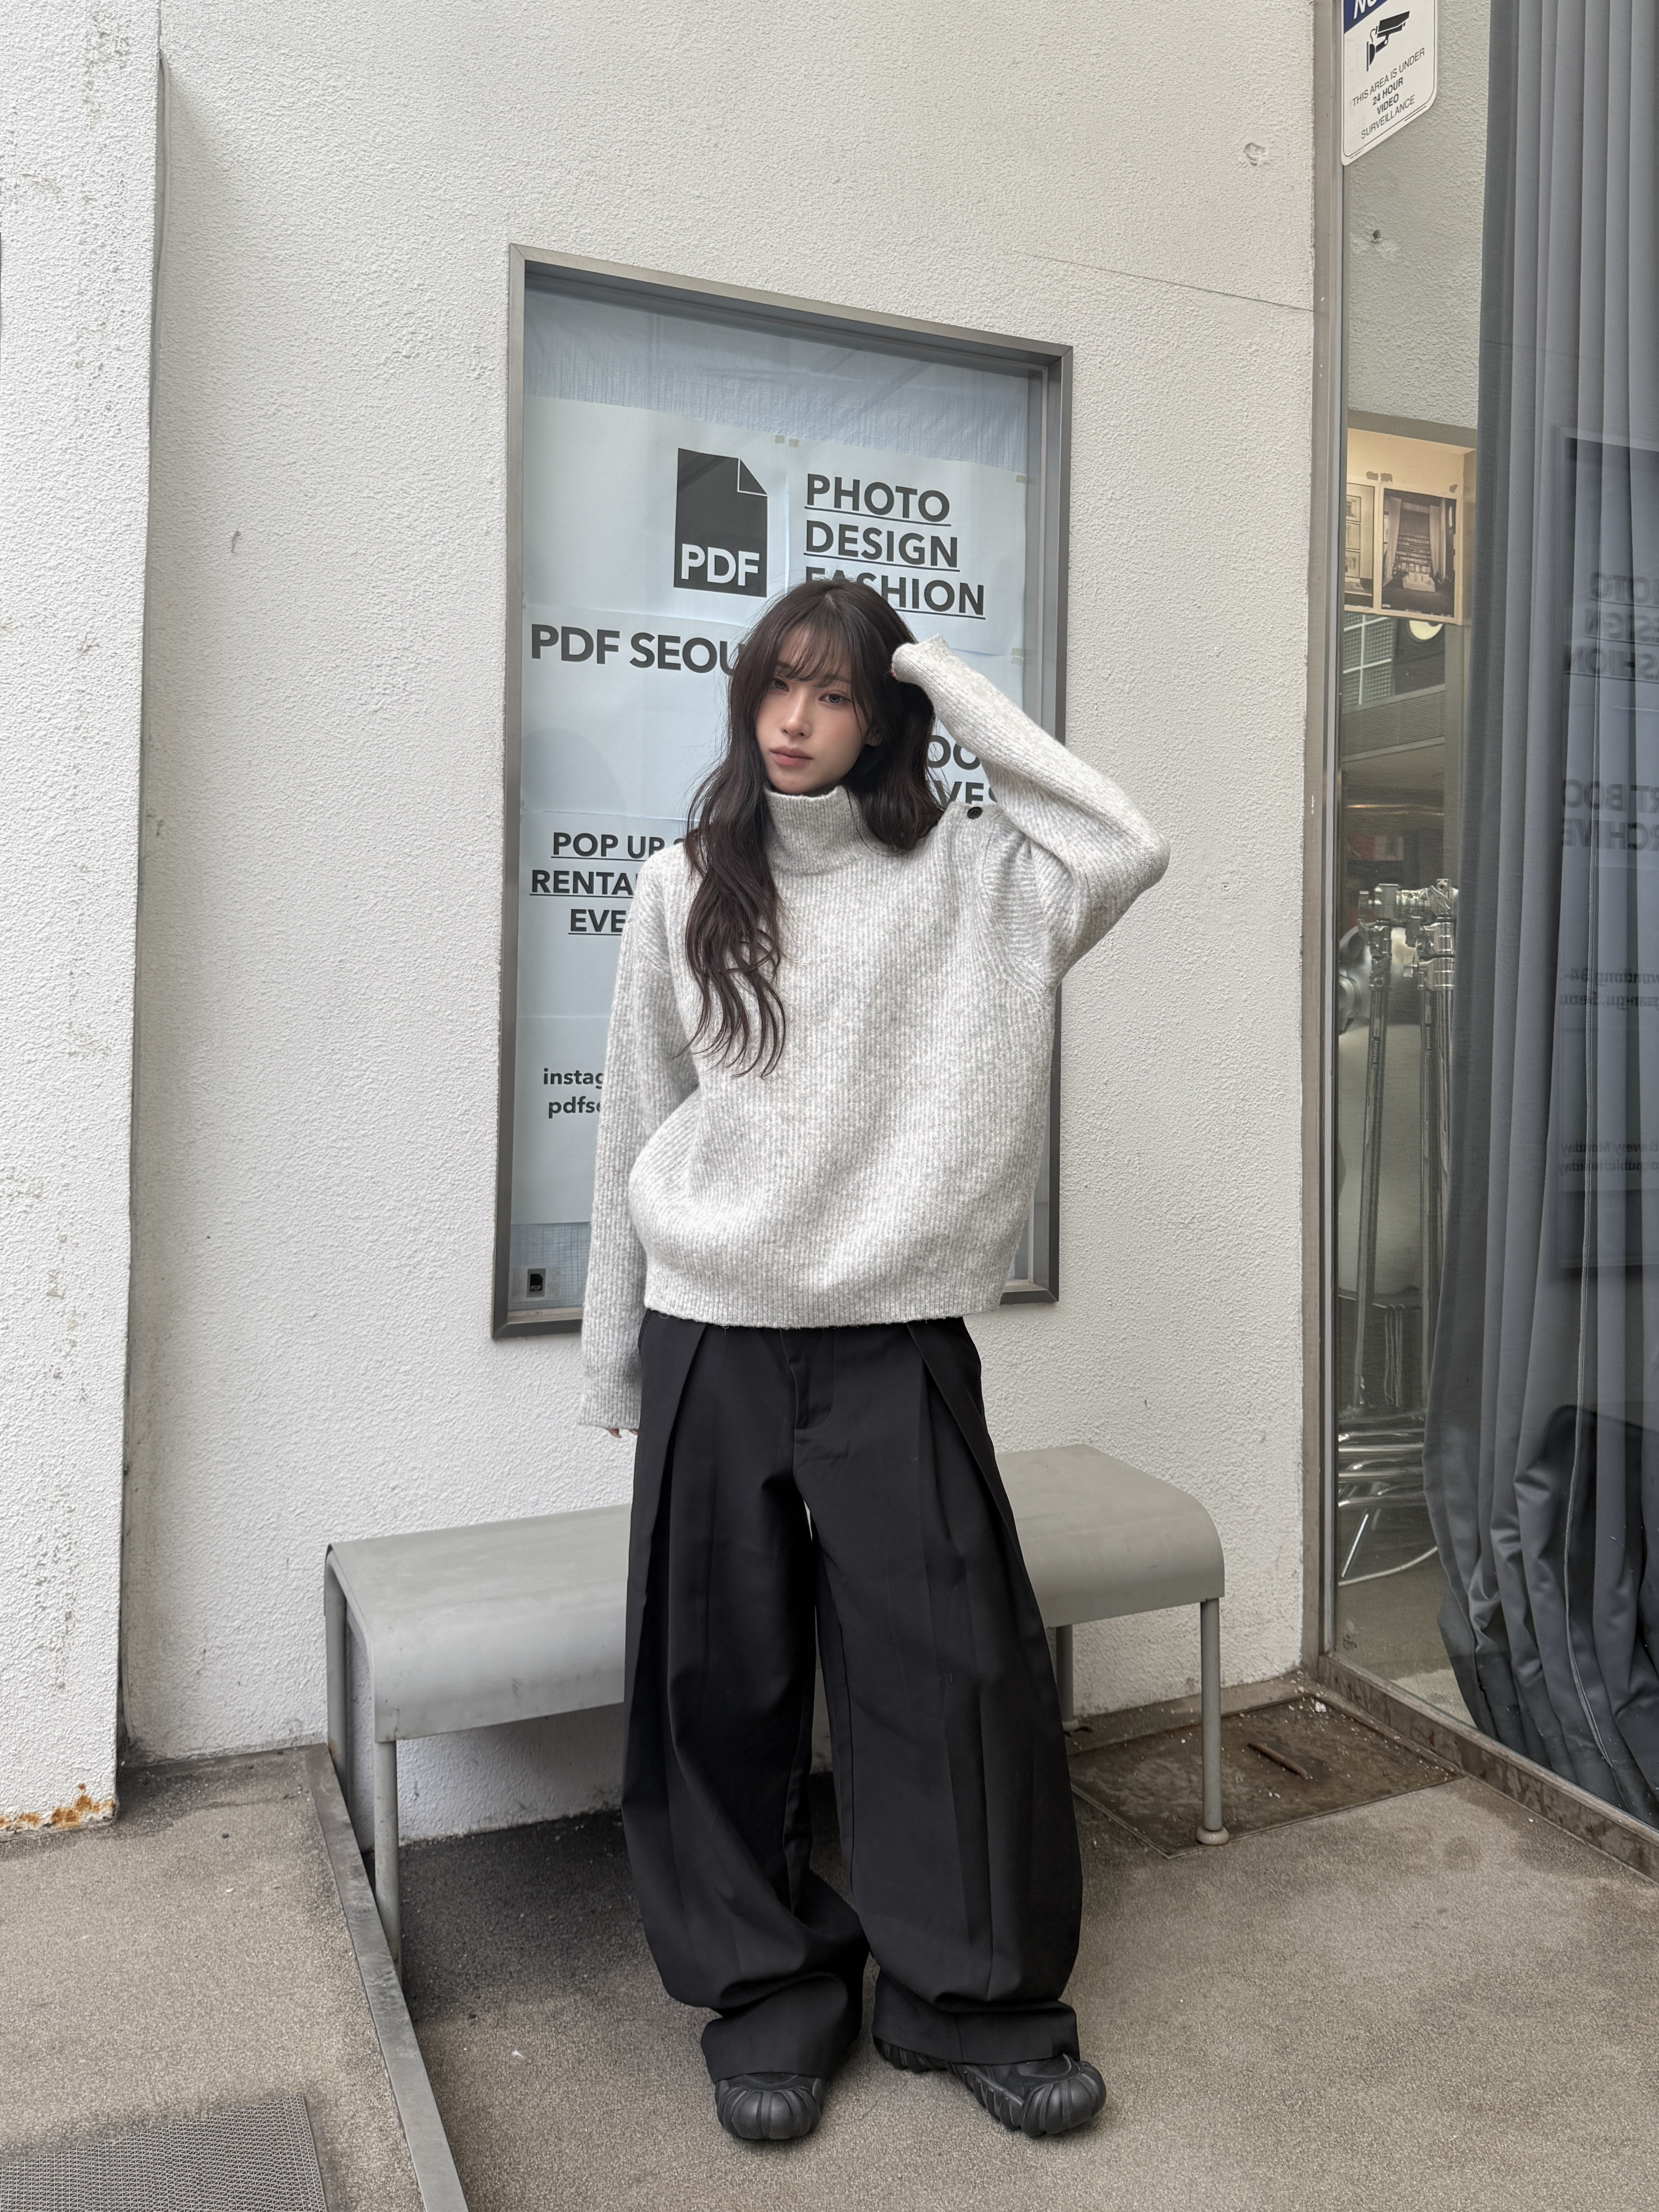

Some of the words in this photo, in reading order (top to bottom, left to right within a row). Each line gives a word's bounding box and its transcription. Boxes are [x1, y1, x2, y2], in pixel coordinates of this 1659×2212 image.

[1352, 89, 1368, 106] THIS
[1370, 75, 1389, 95] AREA
[1391, 68, 1397, 79] IS
[1399, 48, 1425, 73] UNDER
[1373, 93, 1381, 105] 24
[1383, 77, 1403, 98] HOUR
[1361, 95, 1415, 139] SURVEILLANCE
[1377, 94, 1399, 114] VIDEO
[807, 473, 950, 522] PHOTO
[681, 543, 759, 586] PDF
[806, 520, 958, 568] DESIGN
[532, 624, 620, 664] PDF
[554, 832, 618, 856] POP
[627, 836, 665, 858] UP
[532, 870, 638, 895] RENTA
